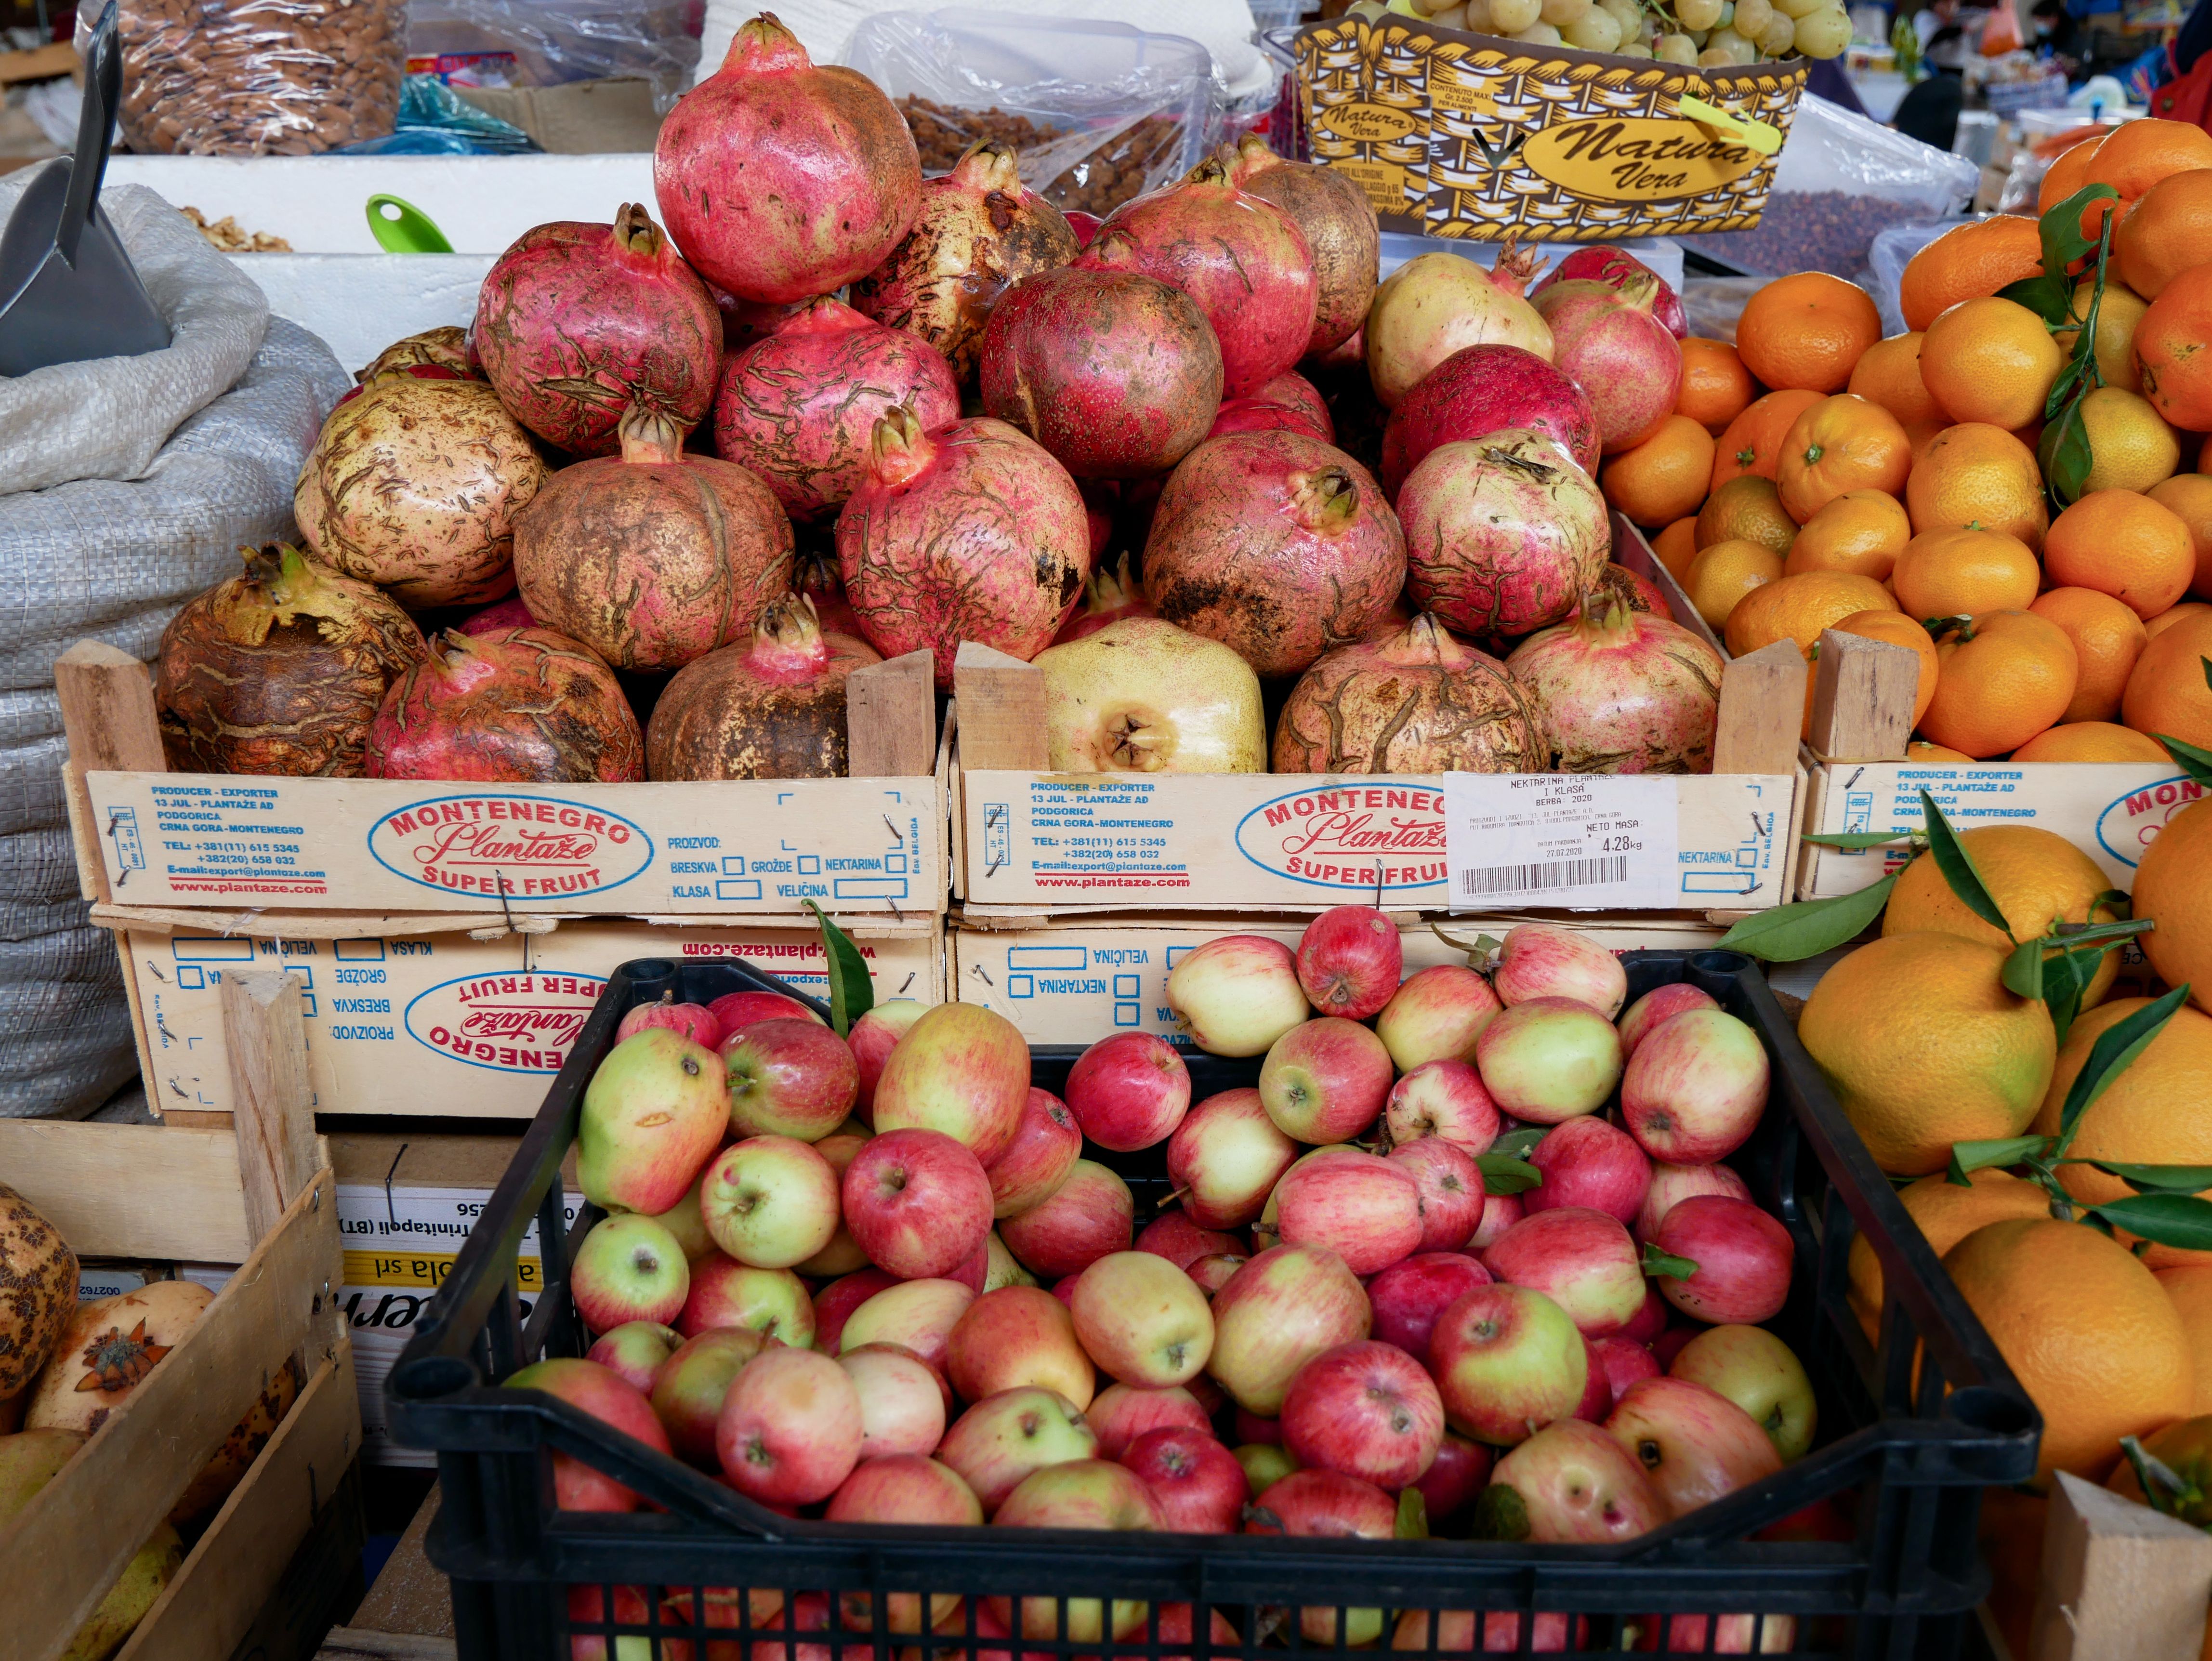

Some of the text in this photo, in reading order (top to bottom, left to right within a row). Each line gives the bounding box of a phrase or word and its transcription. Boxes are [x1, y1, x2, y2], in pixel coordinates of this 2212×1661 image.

[1430, 82, 1472, 96] CONTENUTO
[1451, 102, 1477, 112] ALIMENTI
[1328, 105, 1407, 129] Natura
[1349, 121, 1381, 137] Vera
[1554, 122, 1751, 164] Natura
[1610, 161, 1687, 190] Vera
[1897, 770, 1958, 779] PRODUCER
[1966, 771, 2023, 780] EXPORTER
[1031, 783, 1089, 791] PRODUCER
[1100, 784, 1155, 792] EXPORTER
[1511, 777, 1563, 790] NEKTARINA
[1897, 783, 1909, 791] 13
[1910, 782, 1933, 792] JUL
[1942, 782, 1998, 792] PLANTAŽE
[2001, 784, 2015, 792] AD
[152, 786, 211, 796] PRODUCER
[221, 788, 278, 798] EXPORTER
[1555, 785, 1585, 796] KLASA
[172, 799, 191, 807] JUL
[200, 799, 257, 810] PLANTAŽE
[260, 802, 274, 810] AD
[1047, 795, 1067, 803] JUL
[1077, 794, 1131, 804] PLANTAŽE
[1134, 796, 1148, 804] AD
[1572, 794, 1592, 803] 2020
[1893, 795, 1959, 805] PODGRICA
[158, 811, 221, 820] PODGORICA
[1032, 807, 1093, 816] PODGORICA
[1891, 807, 1922, 816] CRNA
[159, 823, 190, 831] CRNA
[389, 801, 631, 844] MONTENEGRO
[1032, 818, 1061, 827] CRNA
[1587, 822, 1609, 832] NETO
[163, 841, 300, 853] TEL: +381(11) 615 5345
[413, 820, 597, 864] Plantaže
[668, 836, 720, 849] PROIZVOD:
[1033, 837, 1166, 847] TEL: +381(11) 615 5345
[1065, 849, 1113, 859] +382(20)
[1140, 850, 1159, 858] 032
[1547, 847, 1581, 857] 27.07.2020
[1678, 851, 1732, 863] NEKTARINA
[199, 855, 295, 865] +382(20) 658 032
[671, 862, 717, 873] BRESKVA
[826, 858, 882, 870] NEKTARINA
[1287, 857, 1375, 884] SUPER
[423, 866, 599, 894] SUPER FRUIT
[1036, 878, 1190, 888] www.plantaze.com
[171, 882, 327, 894] www.plantaze.com
[673, 882, 829, 898] KLASA VELIČINA
[259, 940, 433, 958] VELIČNA KLASA
[682, 941, 878, 962] w.plantaze.com
[1094, 949, 1148, 967] VELIČINA
[459, 976, 533, 1002] FRUIT
[1039, 979, 1106, 994] NEKTARINA
[333, 999, 391, 1013] BRESKVA
[460, 1010, 586, 1048] lantaže
[429, 1024, 564, 1070] ENEGRO
[379, 1219, 470, 1237] Trinitapoli
[375, 1259, 402, 1279] srl
